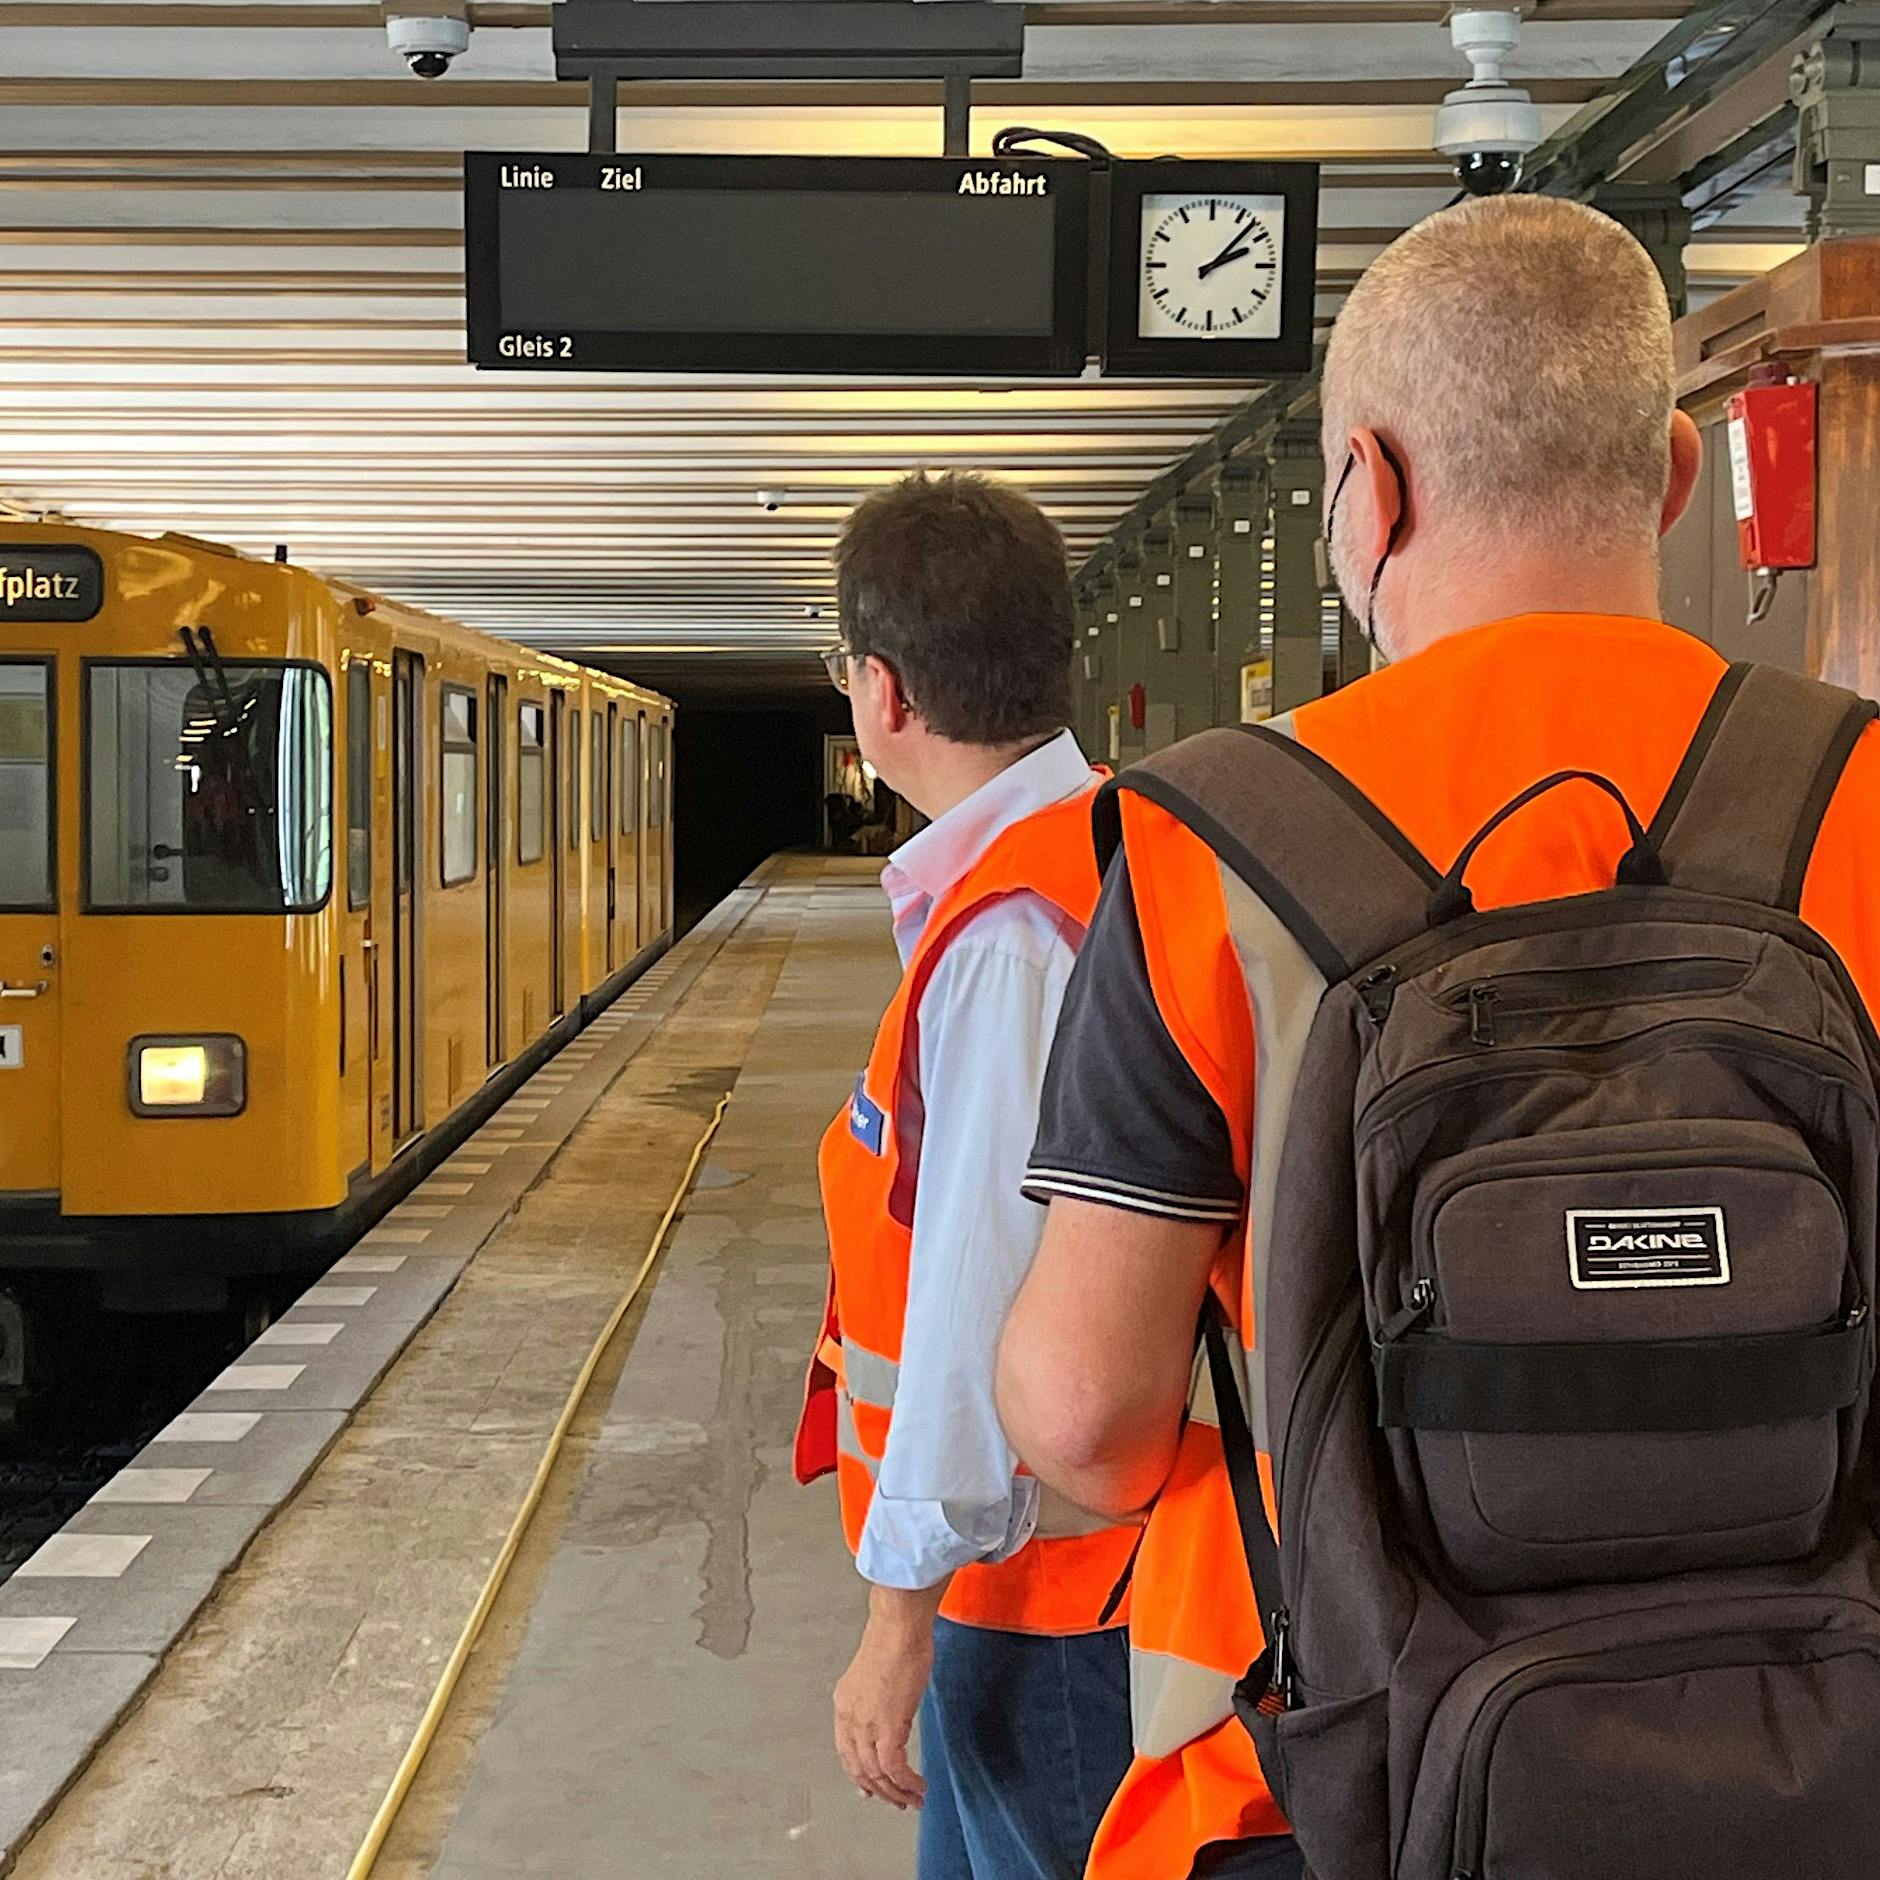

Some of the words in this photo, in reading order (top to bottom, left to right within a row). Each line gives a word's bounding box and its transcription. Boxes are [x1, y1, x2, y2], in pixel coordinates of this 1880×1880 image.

[501, 165, 554, 189] Linie
[601, 166, 642, 190] Ziel
[958, 171, 1047, 196] Abfahrt
[499, 334, 554, 358] Gleis
[560, 336, 573, 358] 2
[0, 566, 80, 607] fplatz
[1586, 1233, 1708, 1251] DAKINE
